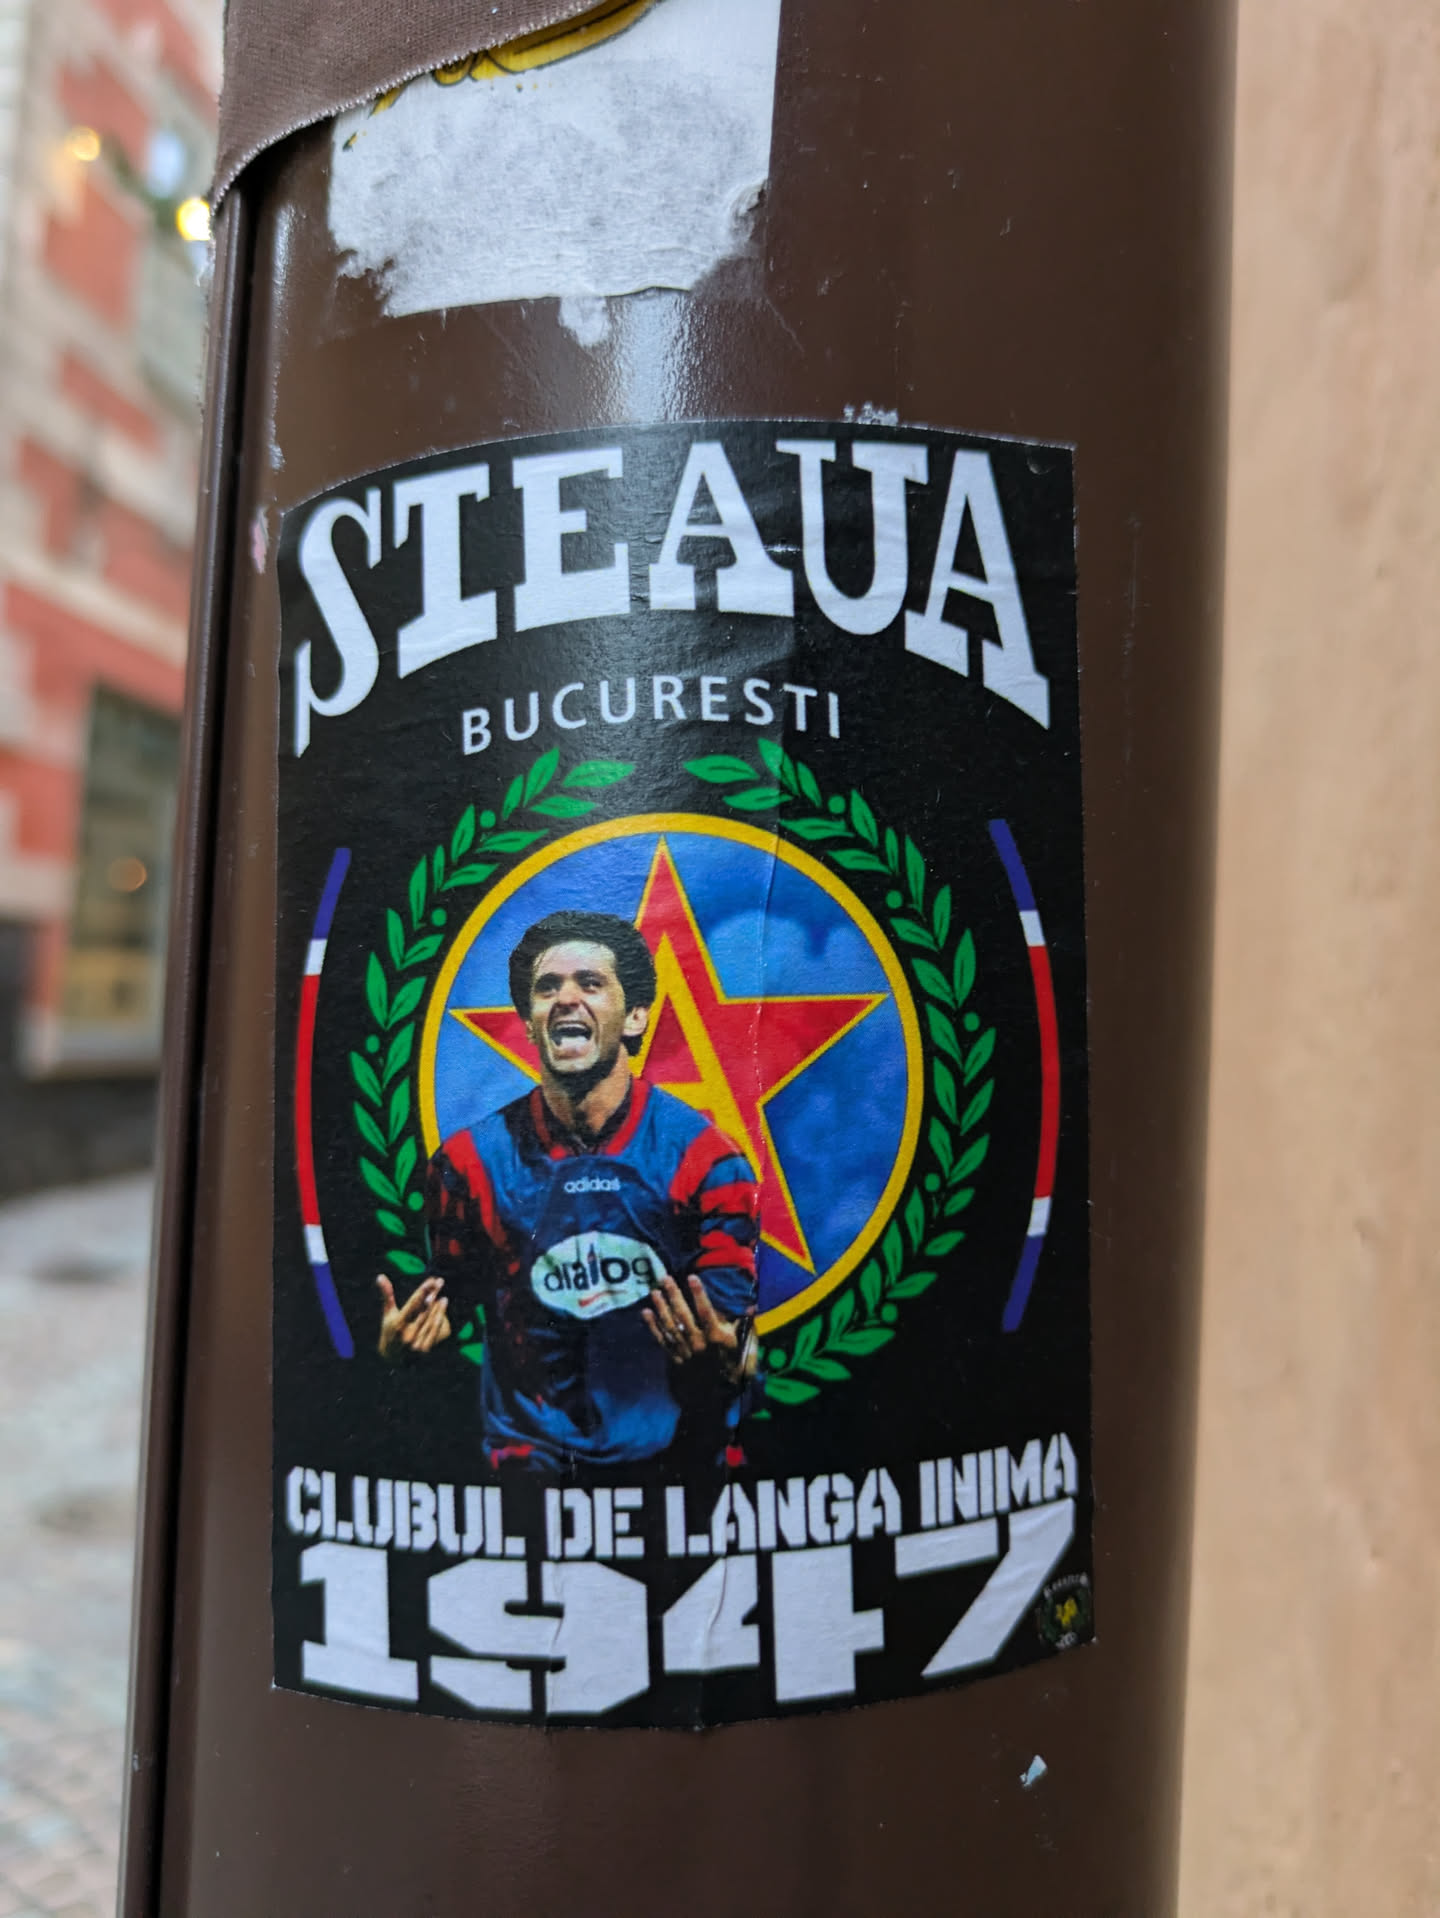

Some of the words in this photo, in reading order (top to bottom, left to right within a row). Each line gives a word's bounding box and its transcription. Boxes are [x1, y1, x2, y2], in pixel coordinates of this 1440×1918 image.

[294, 441, 1050, 758] STEAUA
[462, 675, 841, 755] BUCURESTI
[564, 1176, 621, 1193] adidas
[544, 1243, 657, 1292] dialog
[286, 1465, 527, 1558] CLUBUL
[545, 1486, 646, 1558] DE
[665, 1466, 903, 1558] LANGA
[919, 1432, 1078, 1528] INIMA
[300, 1498, 1076, 1715] 1947
